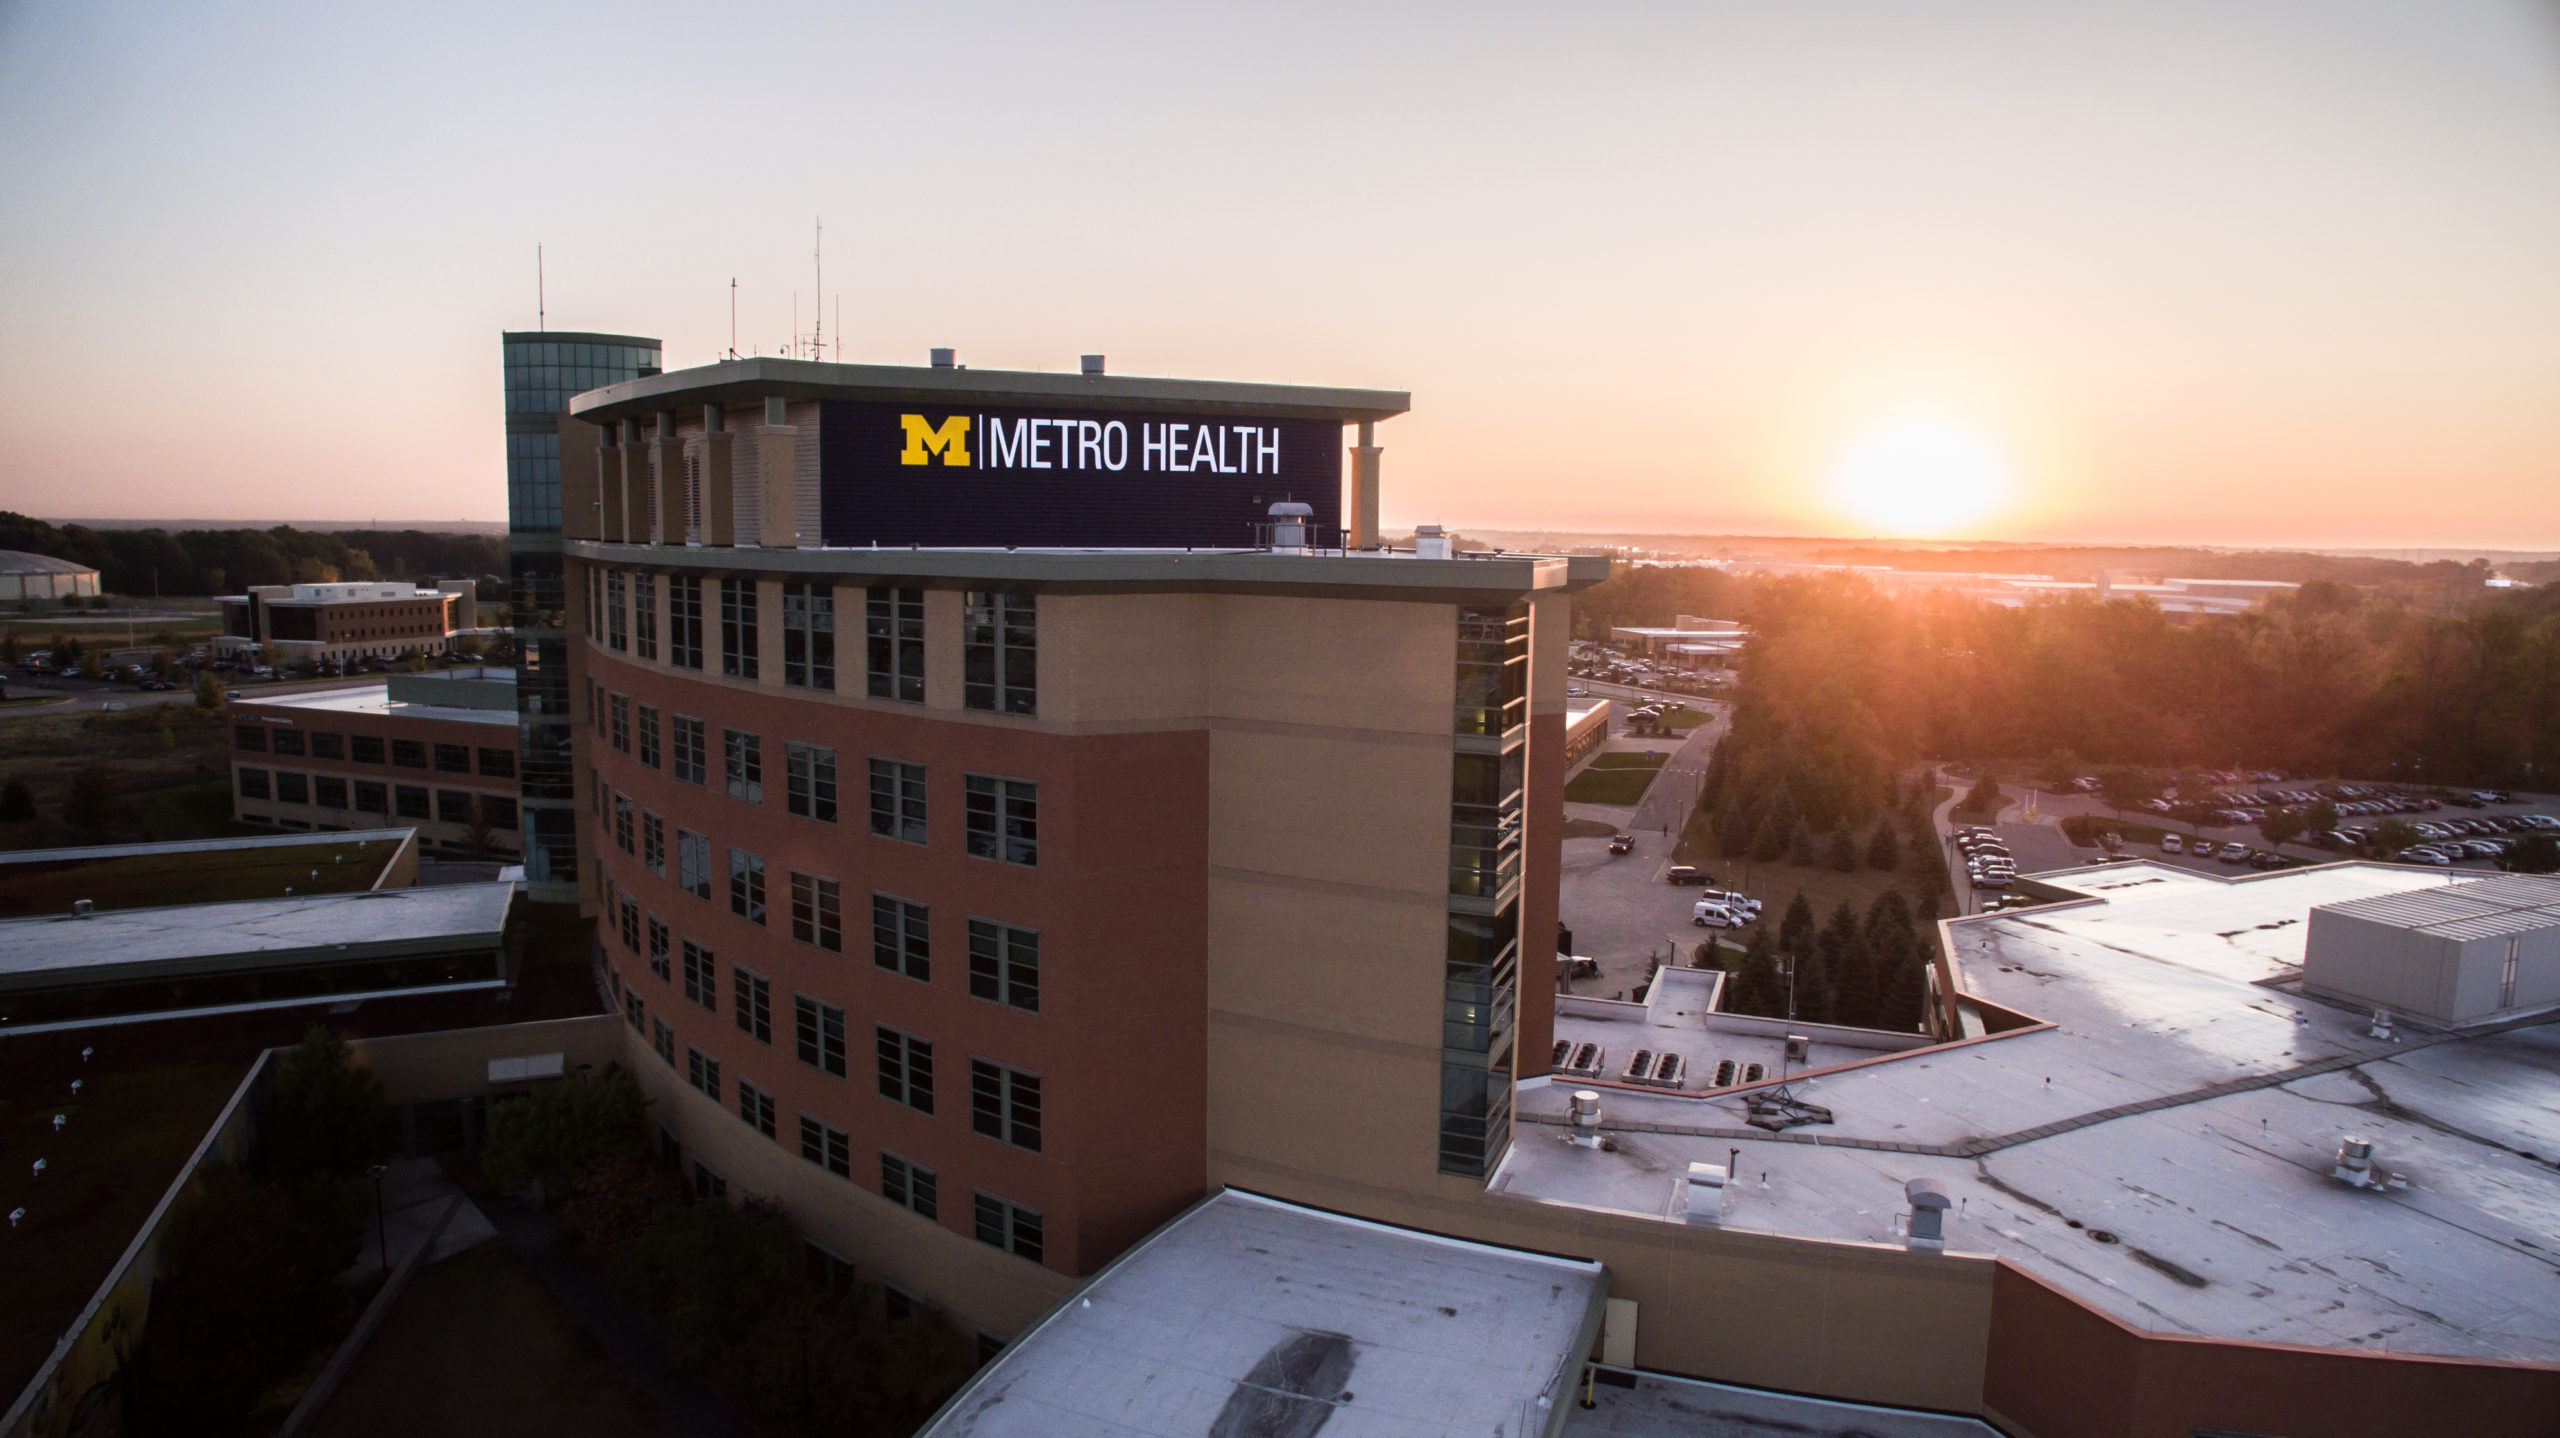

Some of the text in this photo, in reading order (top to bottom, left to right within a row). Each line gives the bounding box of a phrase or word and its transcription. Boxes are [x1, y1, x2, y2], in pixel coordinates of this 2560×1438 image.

[901, 414, 1280, 475] M METRO HEALTH
